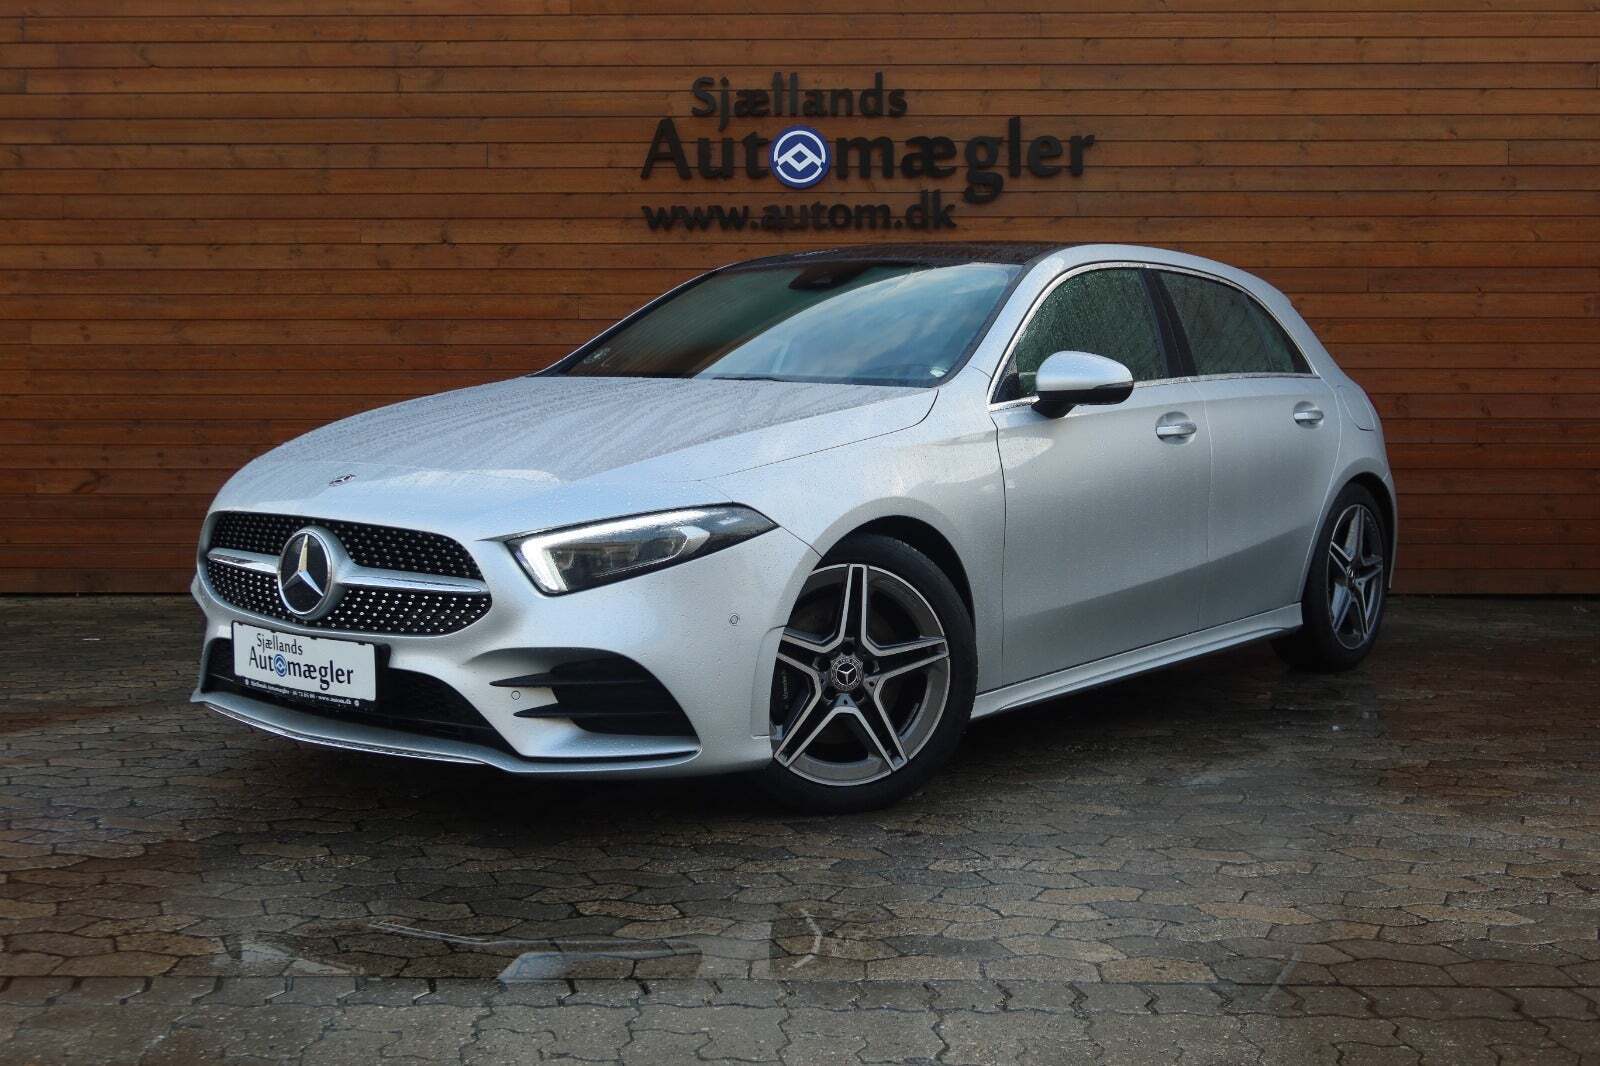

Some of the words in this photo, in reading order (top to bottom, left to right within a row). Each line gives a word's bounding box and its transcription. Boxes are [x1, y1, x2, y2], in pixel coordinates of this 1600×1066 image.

[691, 71, 908, 132] Sjællands
[640, 115, 1096, 204] Automægler
[641, 188, 957, 231] www.autom.dk
[256, 632, 304, 656] Sjællands
[248, 645, 354, 691] Automægler
